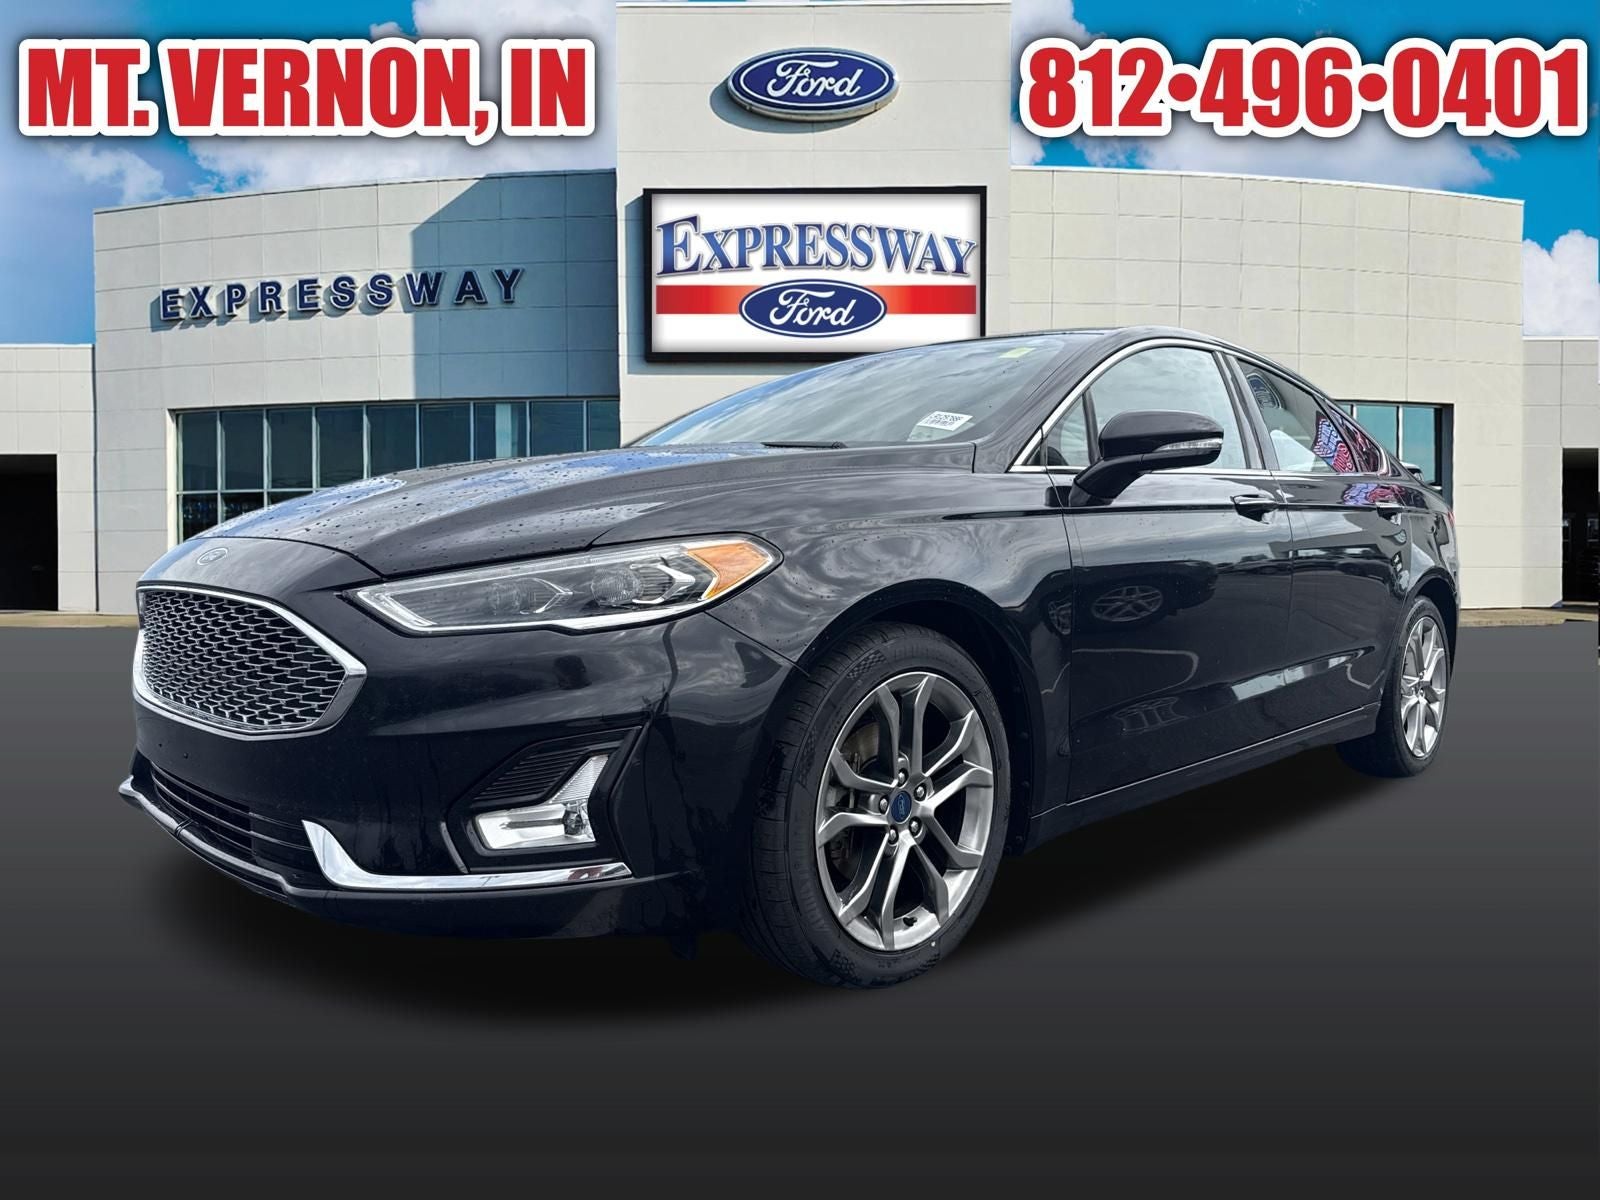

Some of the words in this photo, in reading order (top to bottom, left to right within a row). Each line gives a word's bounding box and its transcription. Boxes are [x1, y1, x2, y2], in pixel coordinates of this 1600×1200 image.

[766, 59, 864, 98] Ford
[656, 214, 977, 277] EXPRESSWAY
[159, 267, 526, 322] EXPRESSWAY
[768, 288, 857, 327] Ford
